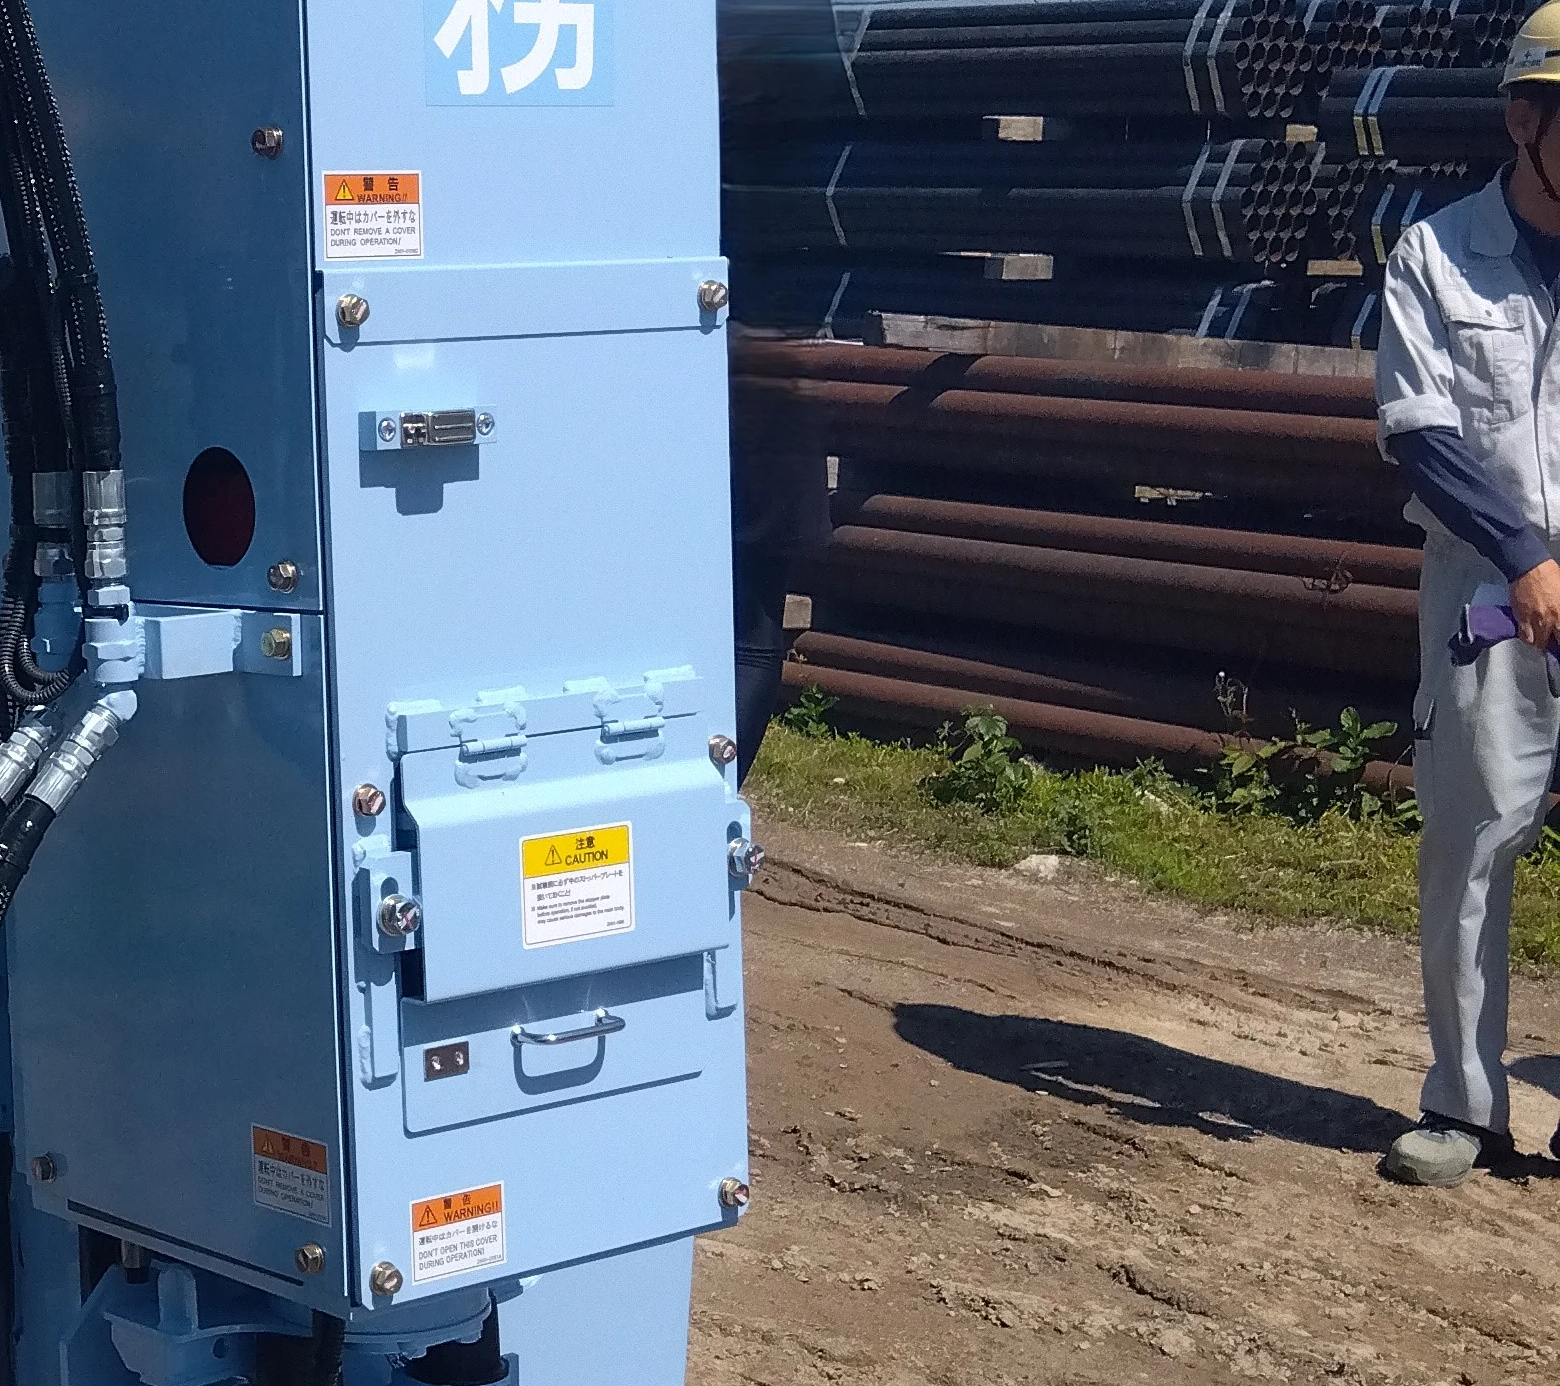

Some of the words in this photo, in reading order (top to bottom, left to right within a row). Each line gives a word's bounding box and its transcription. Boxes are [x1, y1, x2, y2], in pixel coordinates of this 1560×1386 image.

[353, 227, 382, 235] REMOVE
[385, 227, 391, 235] A
[392, 226, 416, 235] COVER
[330, 238, 357, 247] DURING
[575, 835, 596, 851] 注意
[565, 849, 609, 866] CAUTION
[441, 1244, 457, 1254] OPEN
[460, 1240, 474, 1250] THIS
[476, 1234, 497, 1246] COVER
[419, 1259, 444, 1270] DURING
